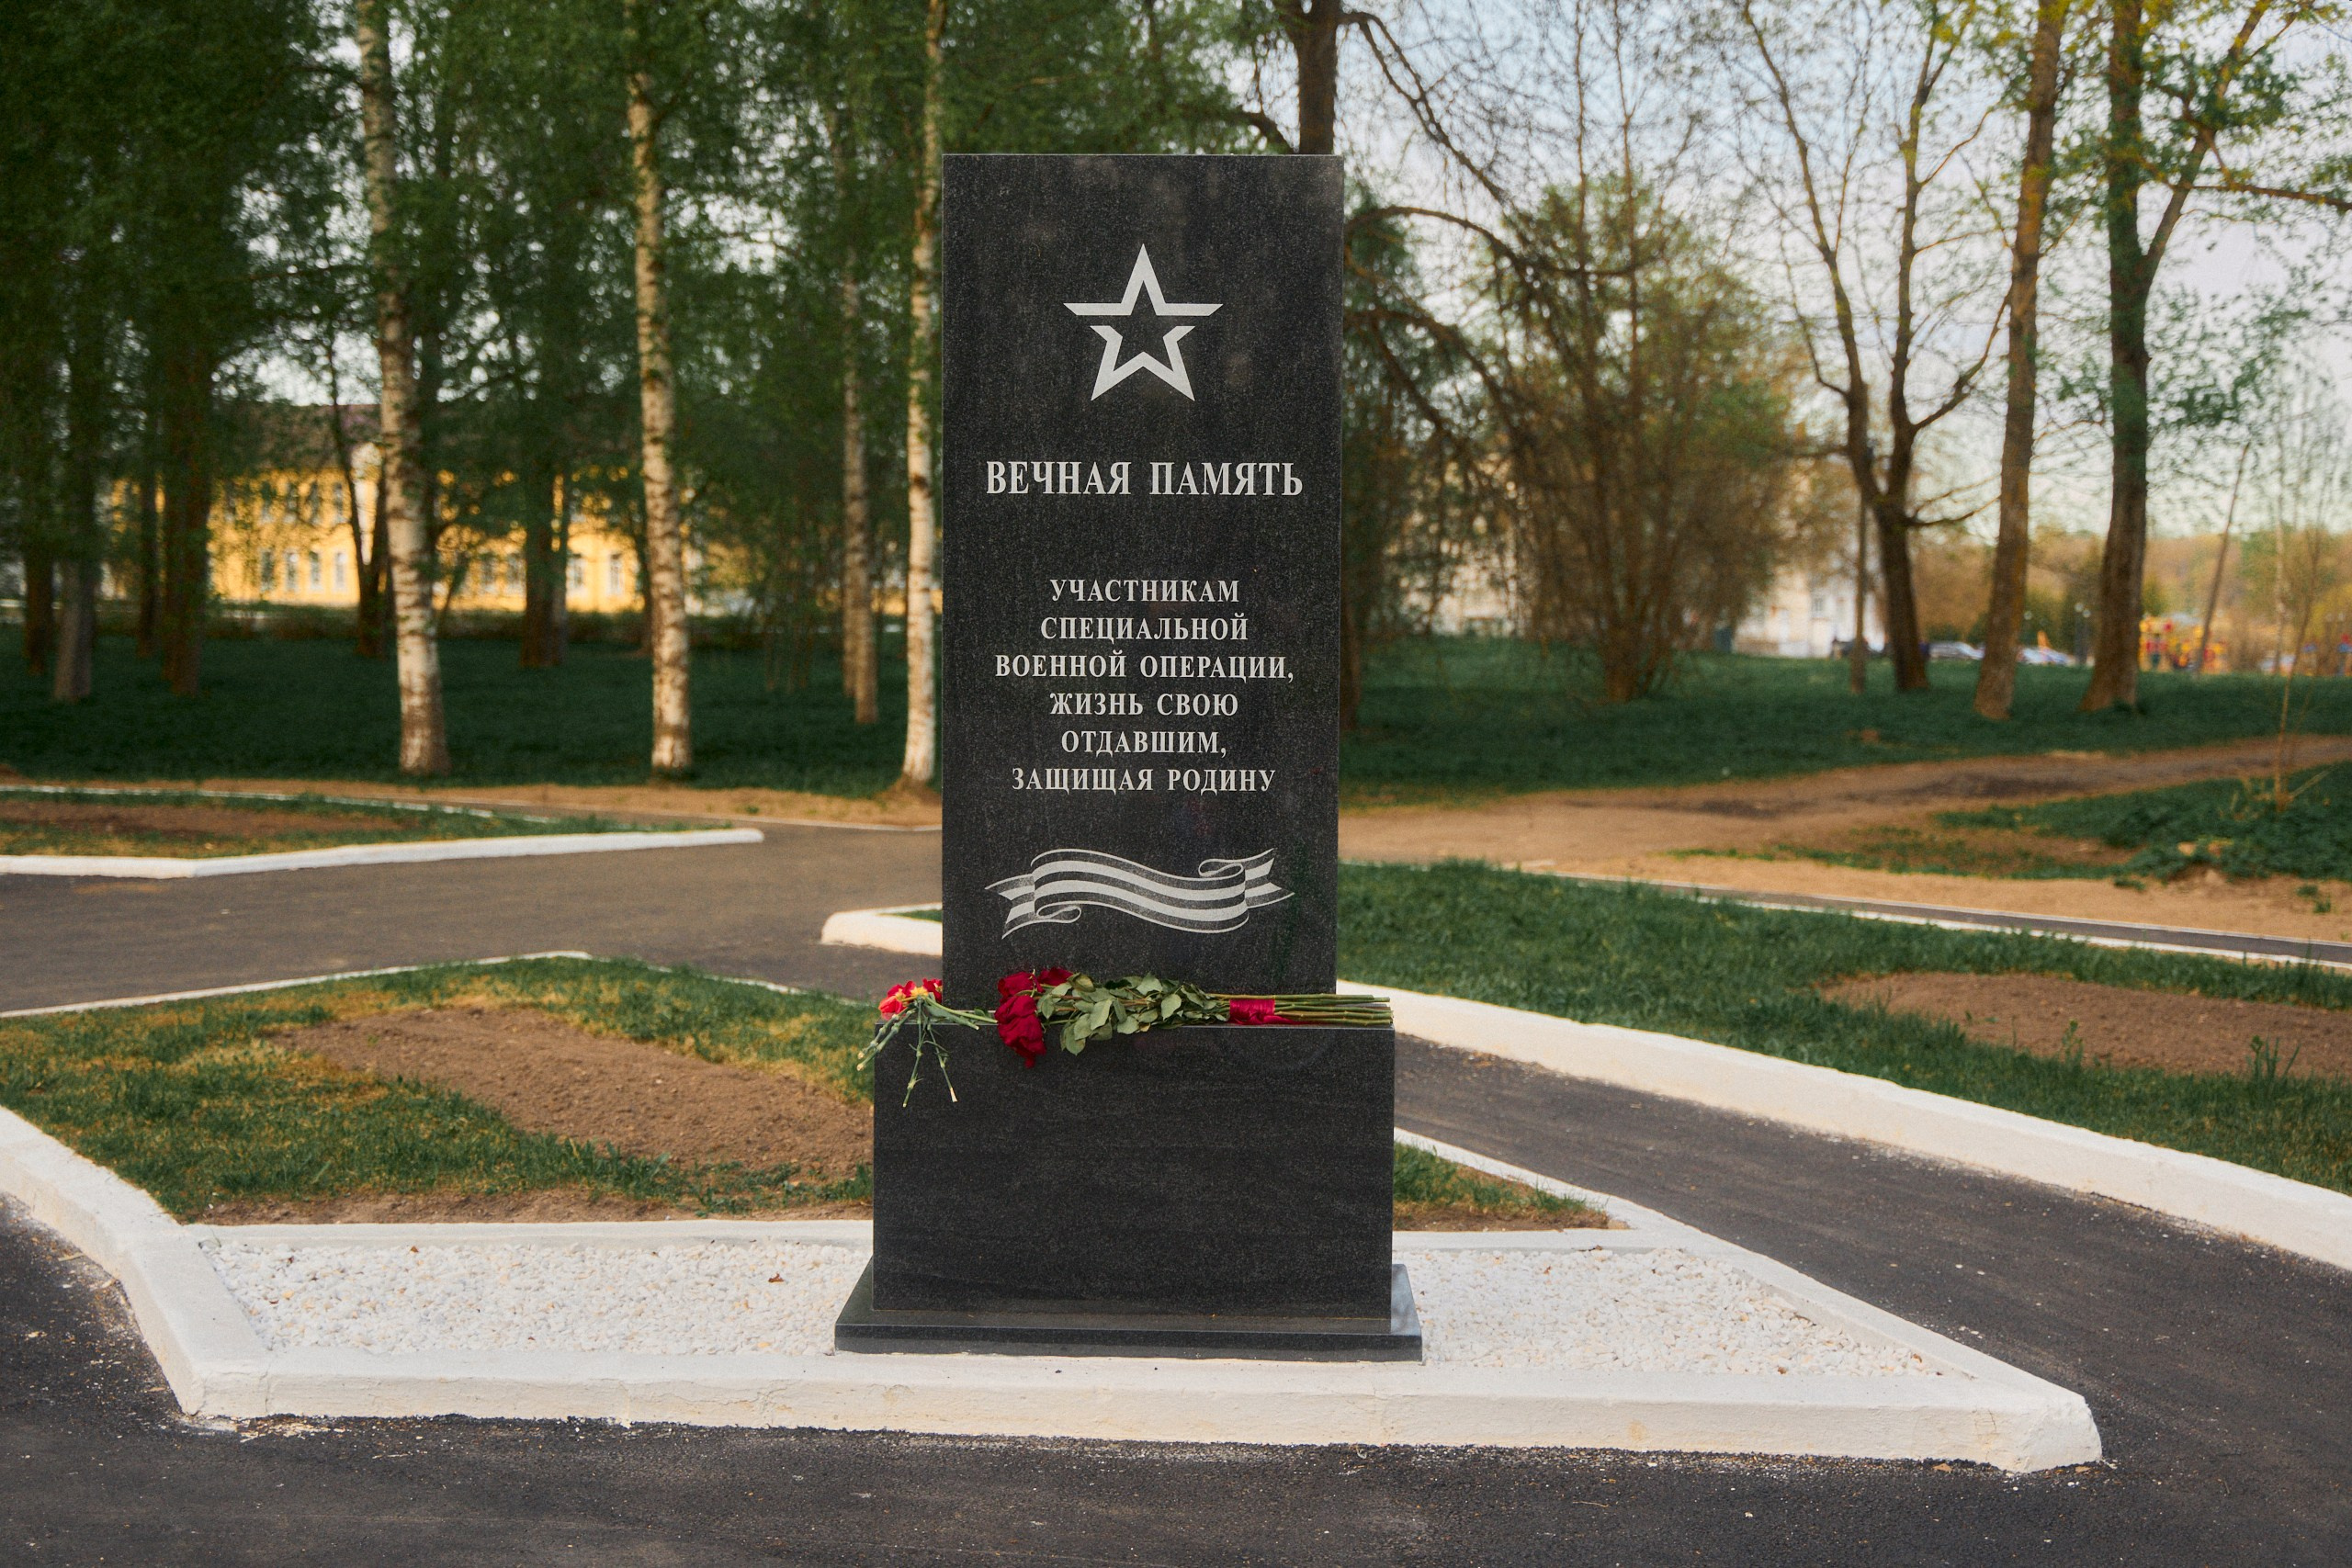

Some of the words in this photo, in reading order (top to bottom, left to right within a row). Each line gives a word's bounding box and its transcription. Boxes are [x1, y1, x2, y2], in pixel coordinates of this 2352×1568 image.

[986, 460, 1132, 495] ВЕЧНАЯ
[1148, 461, 1304, 497] ПАМЯТЬ
[1049, 579, 1239, 603] УЧАСТНИКАМ
[1040, 612, 1249, 644] СПЕЦИАЛЬНОЙ
[995, 649, 1127, 678] ВОЕННОЙ
[1139, 655, 1294, 683] ОПЕРАЦИИ,
[1049, 693, 1144, 716] ЖИЗНЬ
[1157, 693, 1238, 716] СВОЮ
[1061, 730, 1227, 758] ОТДАВШИМ,
[1012, 767, 1154, 795] ЗАЩИЩАЯ
[1167, 768, 1276, 796] РОДИНУ
